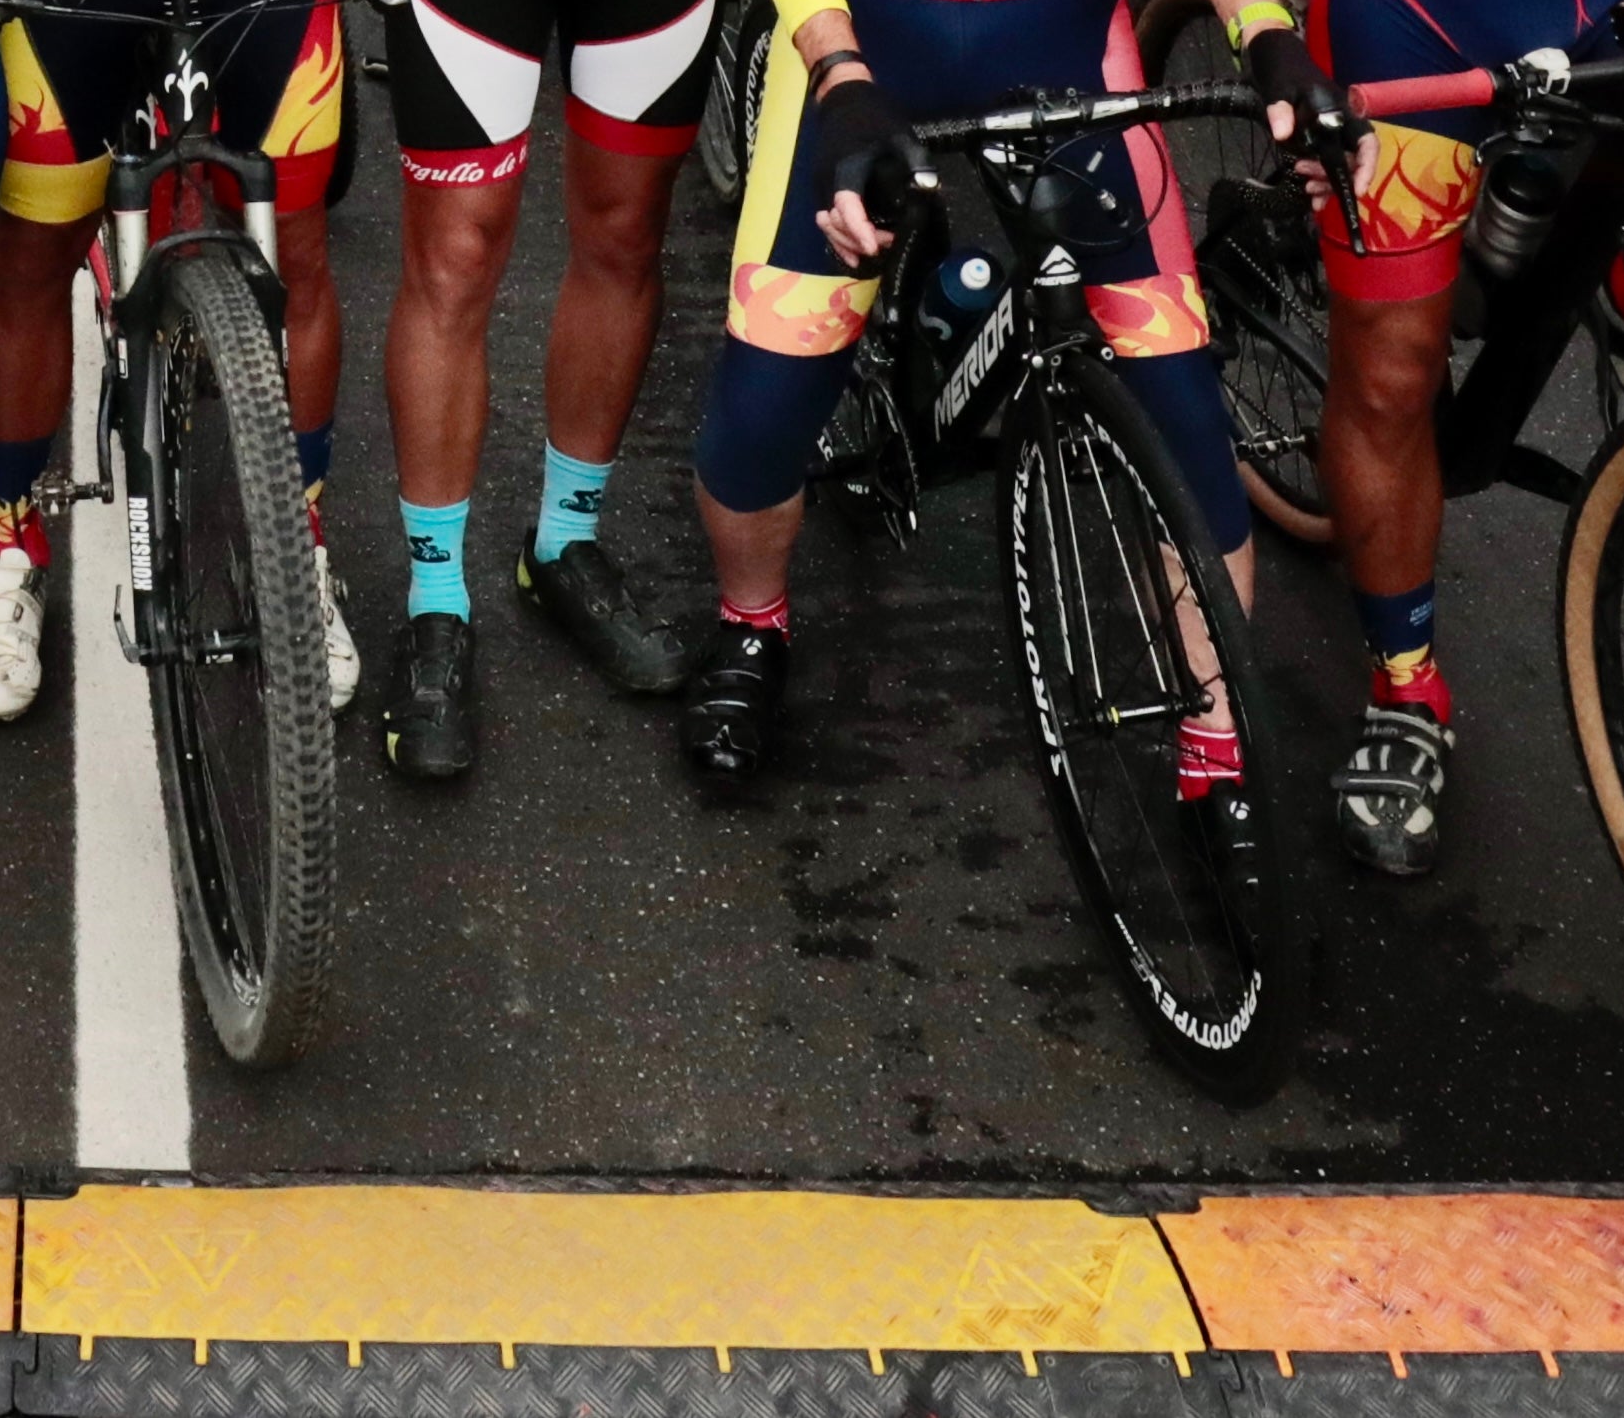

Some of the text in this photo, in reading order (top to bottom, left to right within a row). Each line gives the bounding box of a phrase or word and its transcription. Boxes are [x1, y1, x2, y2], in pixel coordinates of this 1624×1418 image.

[400, 153, 485, 184] Orgullo
[1032, 273, 1081, 287] MERIDA
[934, 287, 1015, 443] MERIDA
[128, 496, 154, 591] ROCKSHOX
